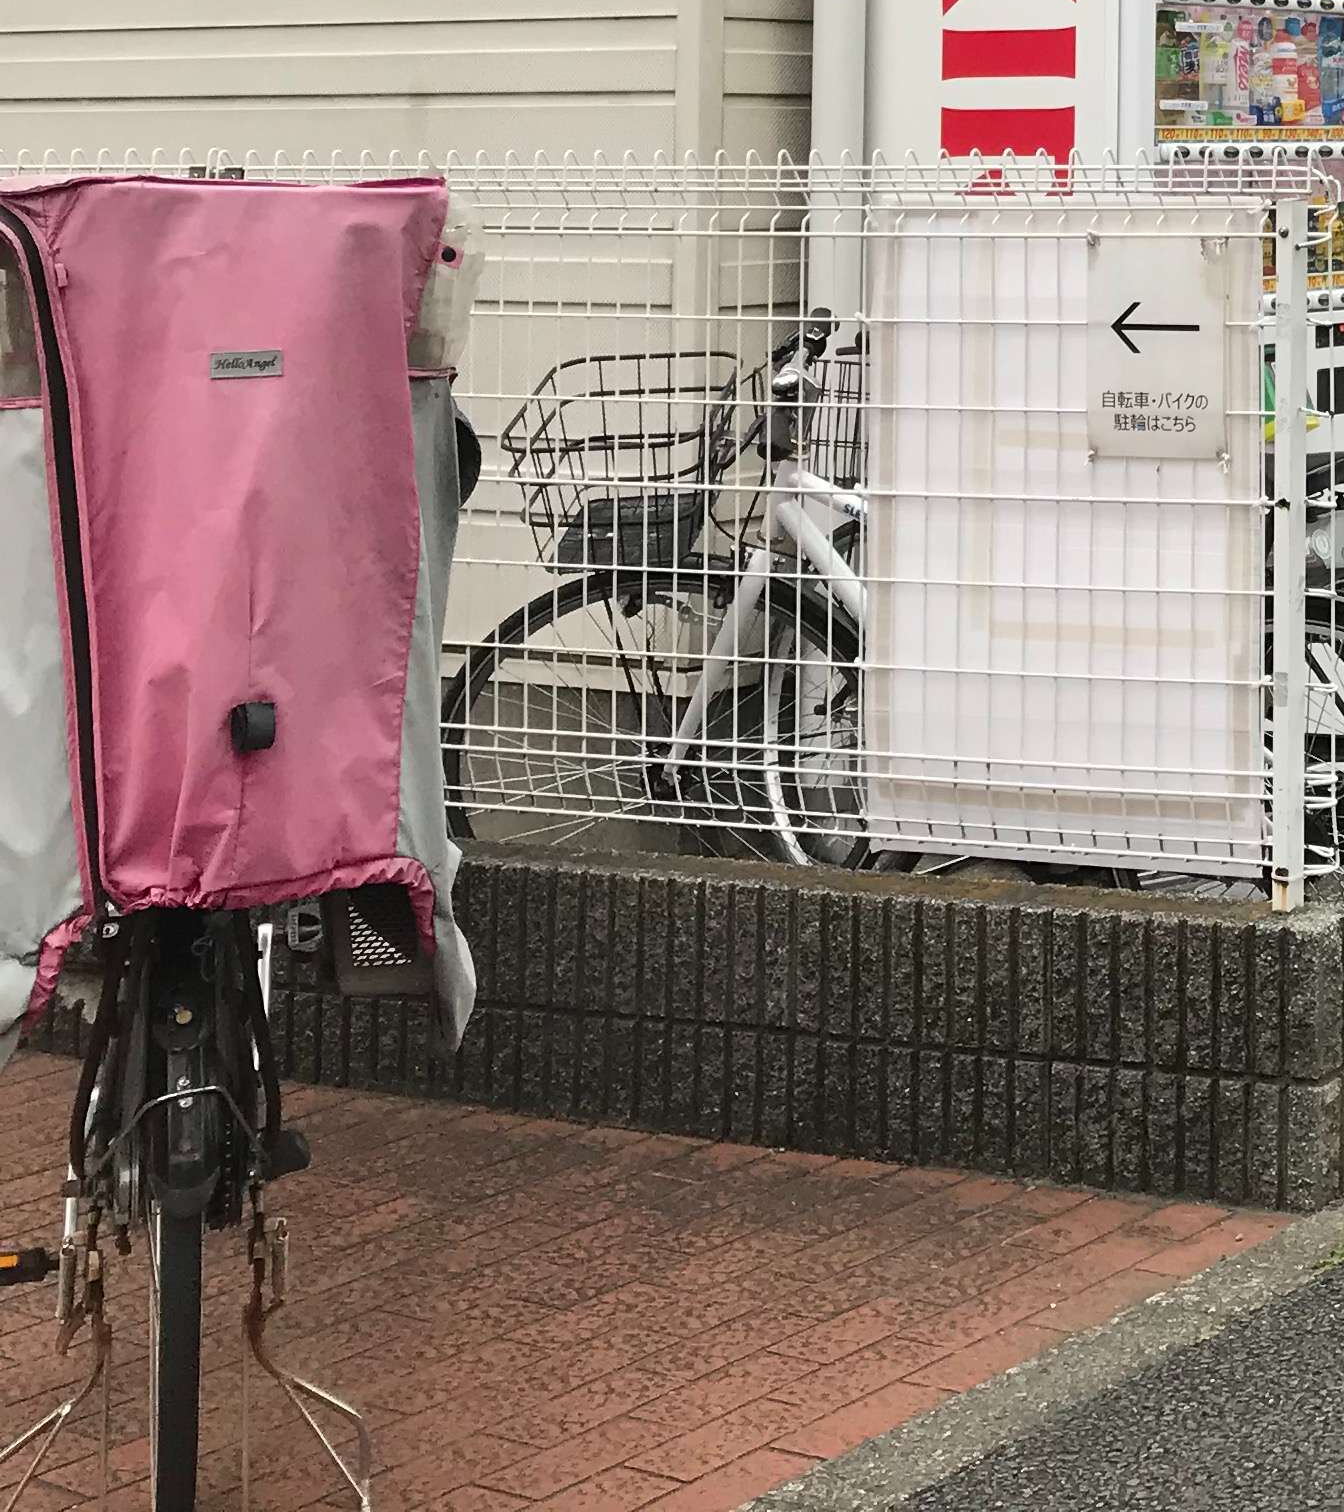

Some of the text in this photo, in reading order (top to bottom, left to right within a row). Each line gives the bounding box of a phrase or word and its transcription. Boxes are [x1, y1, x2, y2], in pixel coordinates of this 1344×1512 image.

[1101, 390, 1209, 410] 自転車・バイクの
[1113, 414, 1197, 433] 駐輪はこちら
